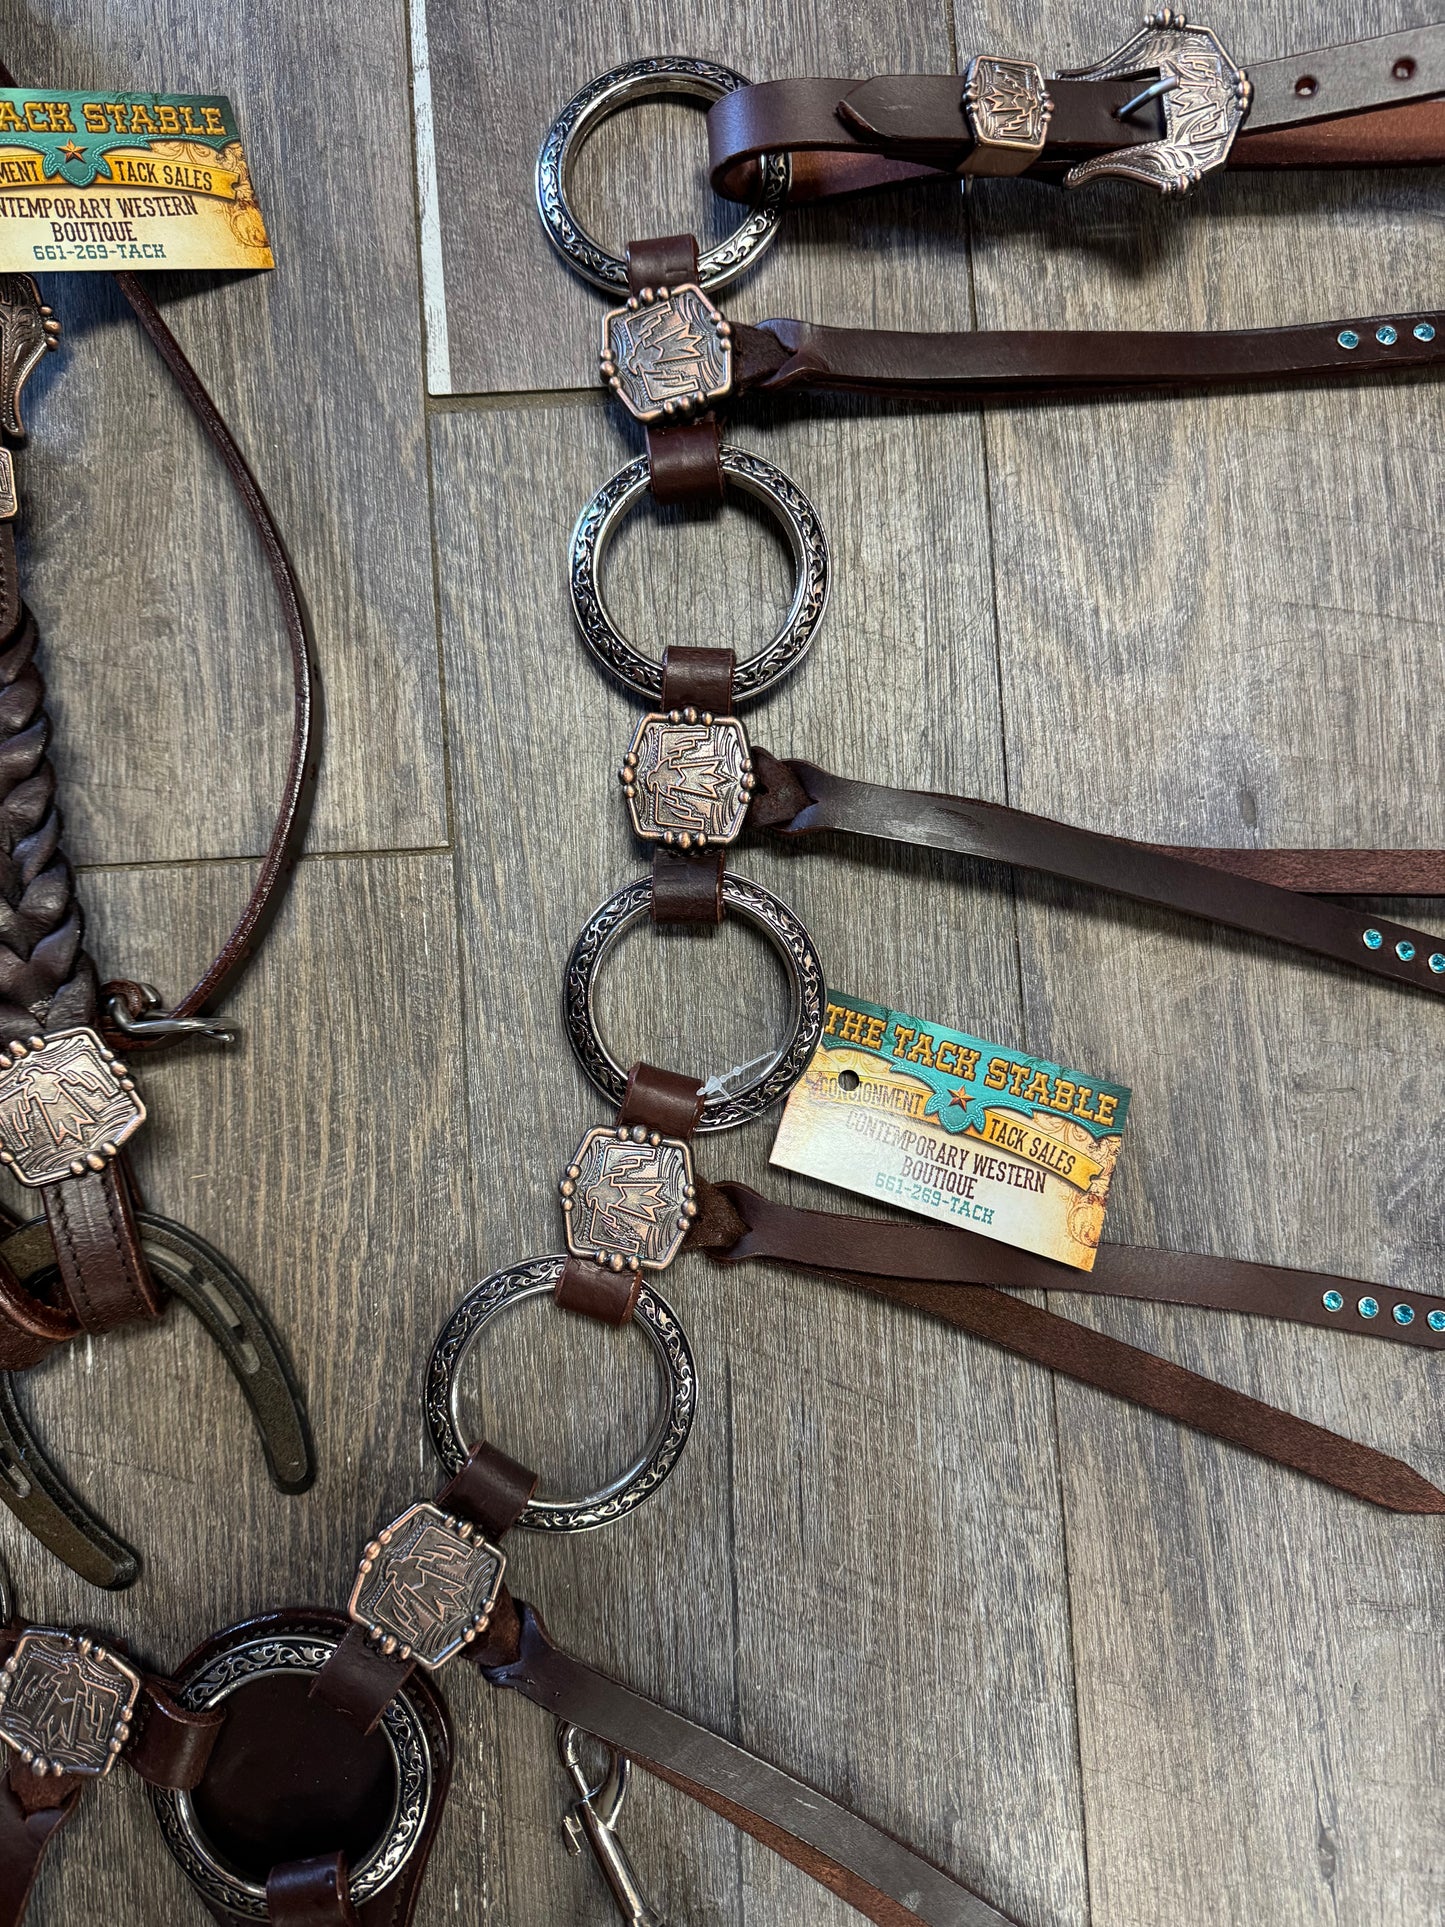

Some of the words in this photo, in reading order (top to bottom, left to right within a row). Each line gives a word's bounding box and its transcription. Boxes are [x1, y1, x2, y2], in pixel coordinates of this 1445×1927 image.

[0, 101, 76, 132] ACK
[81, 103, 227, 136] STABLE
[0, 160, 40, 183] MENT
[114, 160, 159, 184] TACK
[163, 164, 213, 192] SALES
[0, 196, 114, 219] NTEMPORARY
[118, 195, 199, 218] WESTERN
[50, 221, 138, 243] BOUTIQUE
[33, 243, 167, 260] 661-269-TACK
[825, 1003, 887, 1050] THE
[894, 1025, 981, 1081] TACK
[984, 1058, 1118, 1126] STABLE
[845, 1110, 968, 1171] CONTEMPORARY
[973, 1153, 1047, 1194] WESTERN
[990, 1118, 1027, 1152] TACK
[1029, 1138, 1076, 1175] SALES
[900, 1154, 978, 1200] BOUTIQUE
[874, 1171, 996, 1225] 661-269-TACK
